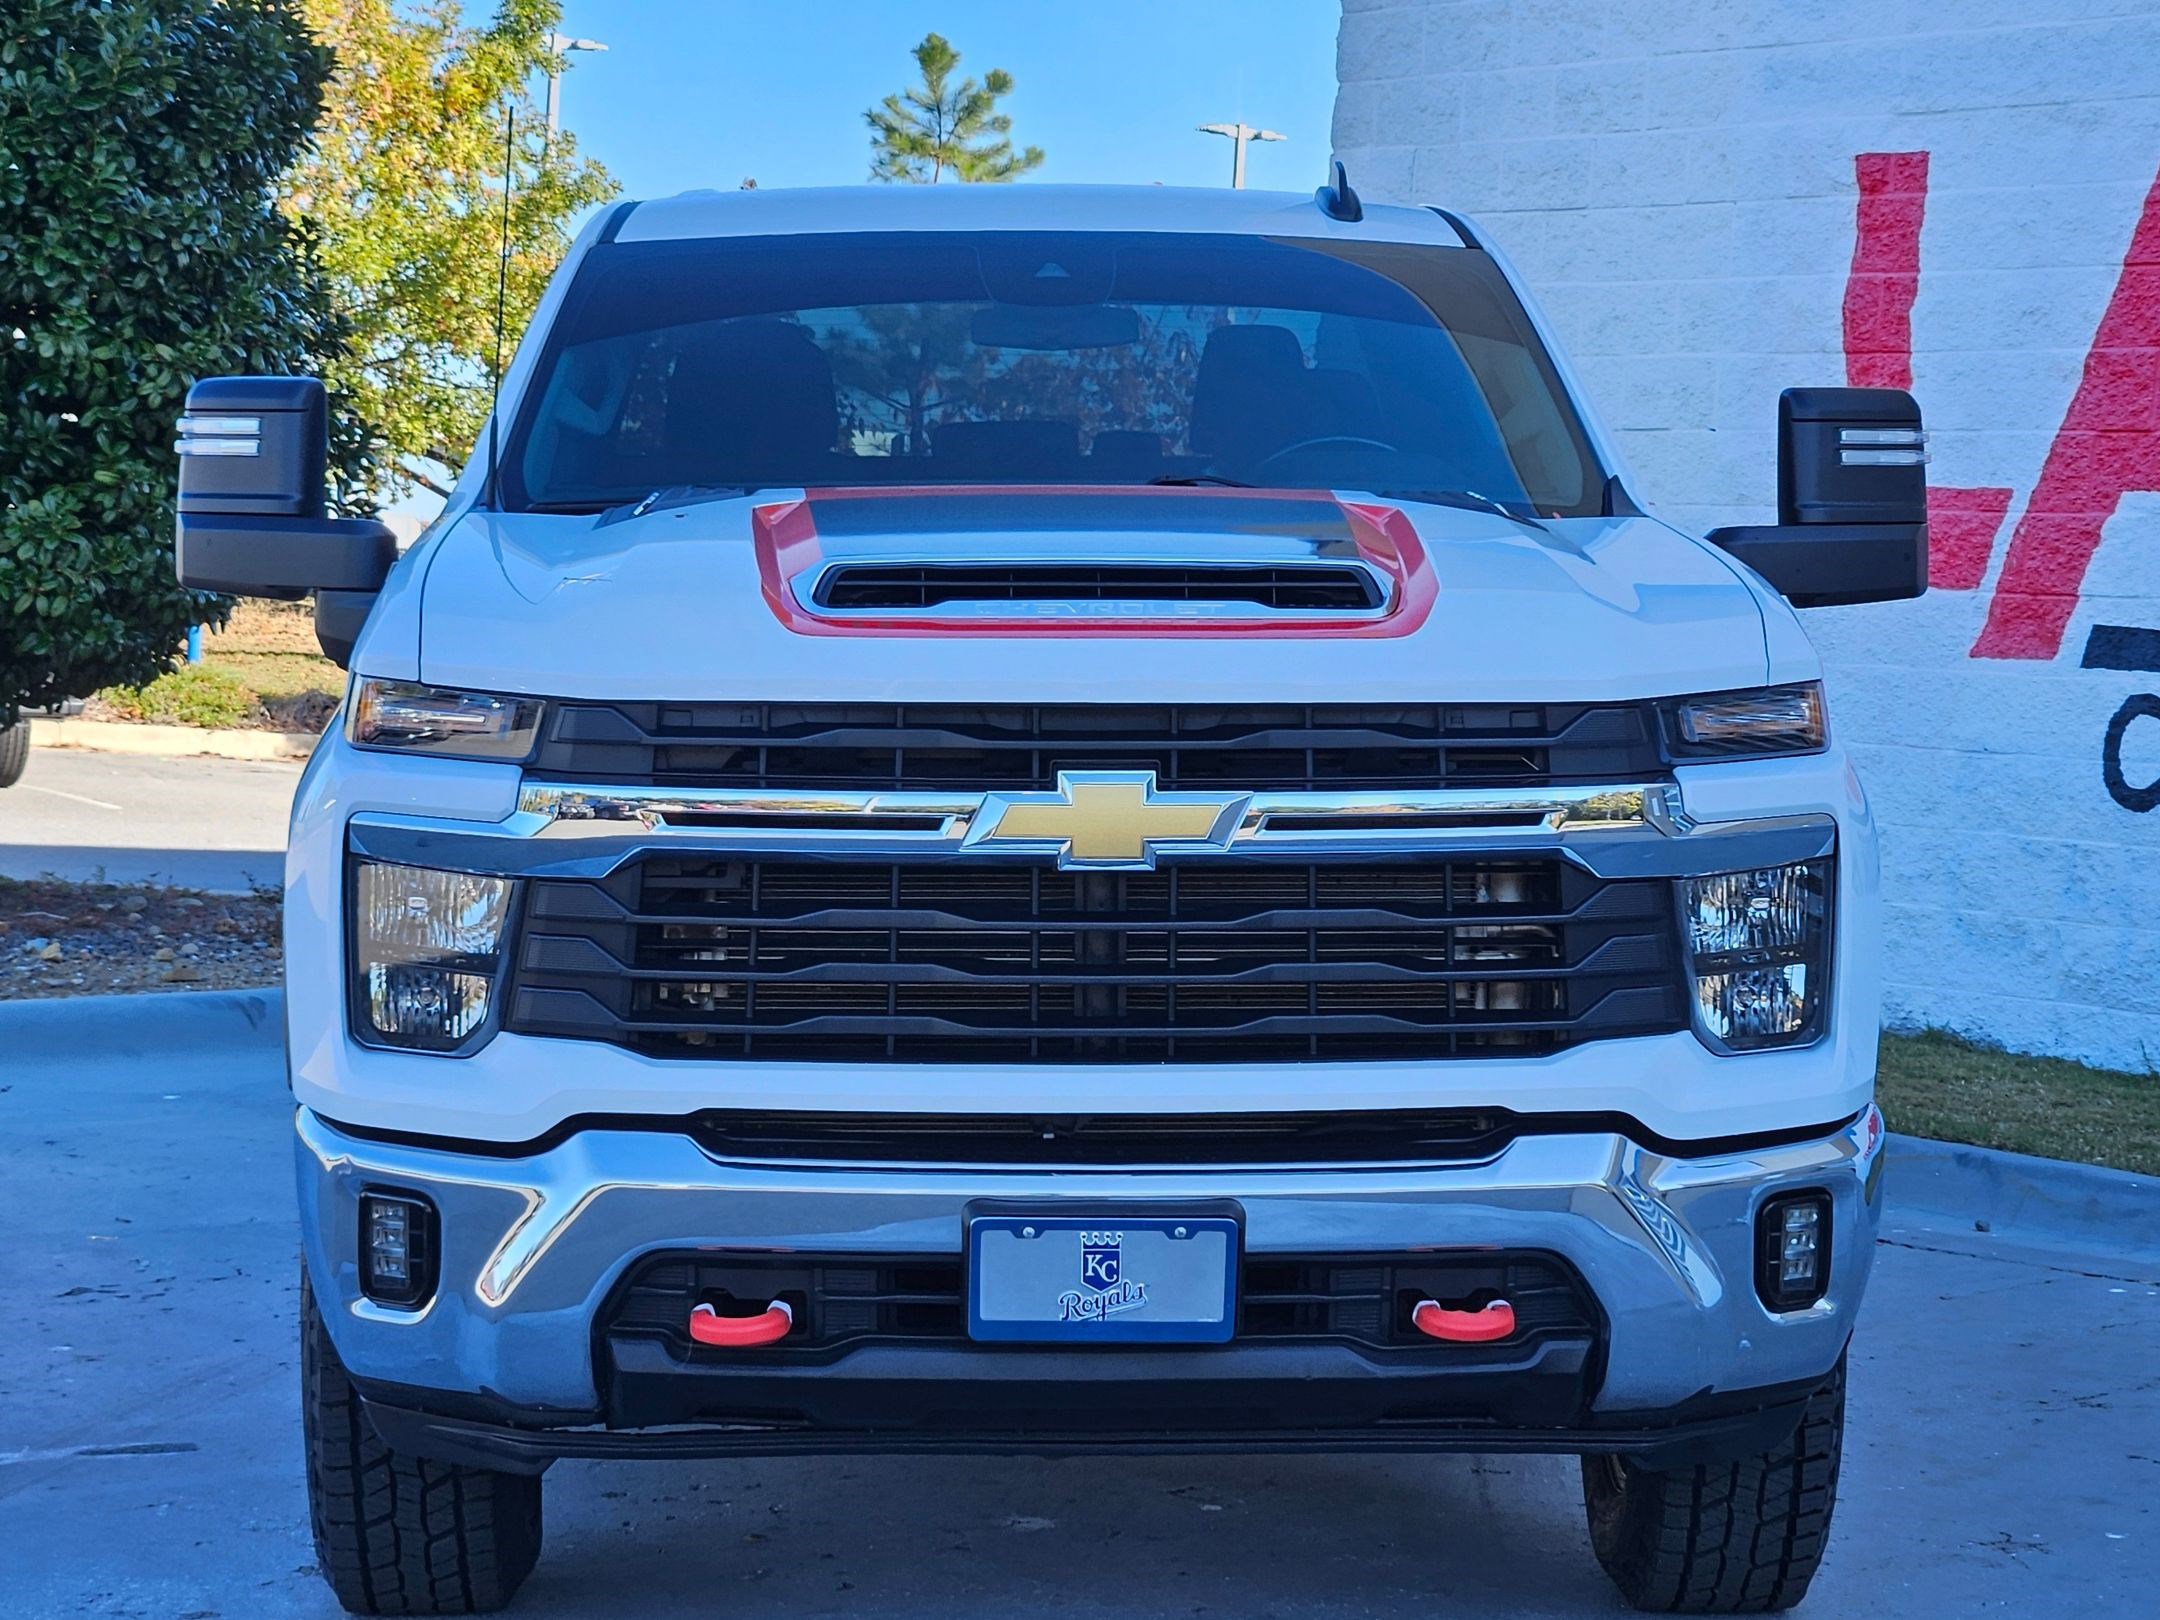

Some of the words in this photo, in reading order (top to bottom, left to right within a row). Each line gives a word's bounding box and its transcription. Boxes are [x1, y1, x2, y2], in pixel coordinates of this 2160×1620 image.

[975, 602, 1227, 615] CHEVROLET
[1085, 1254, 1118, 1282] KC
[1059, 1280, 1147, 1322] Royals
